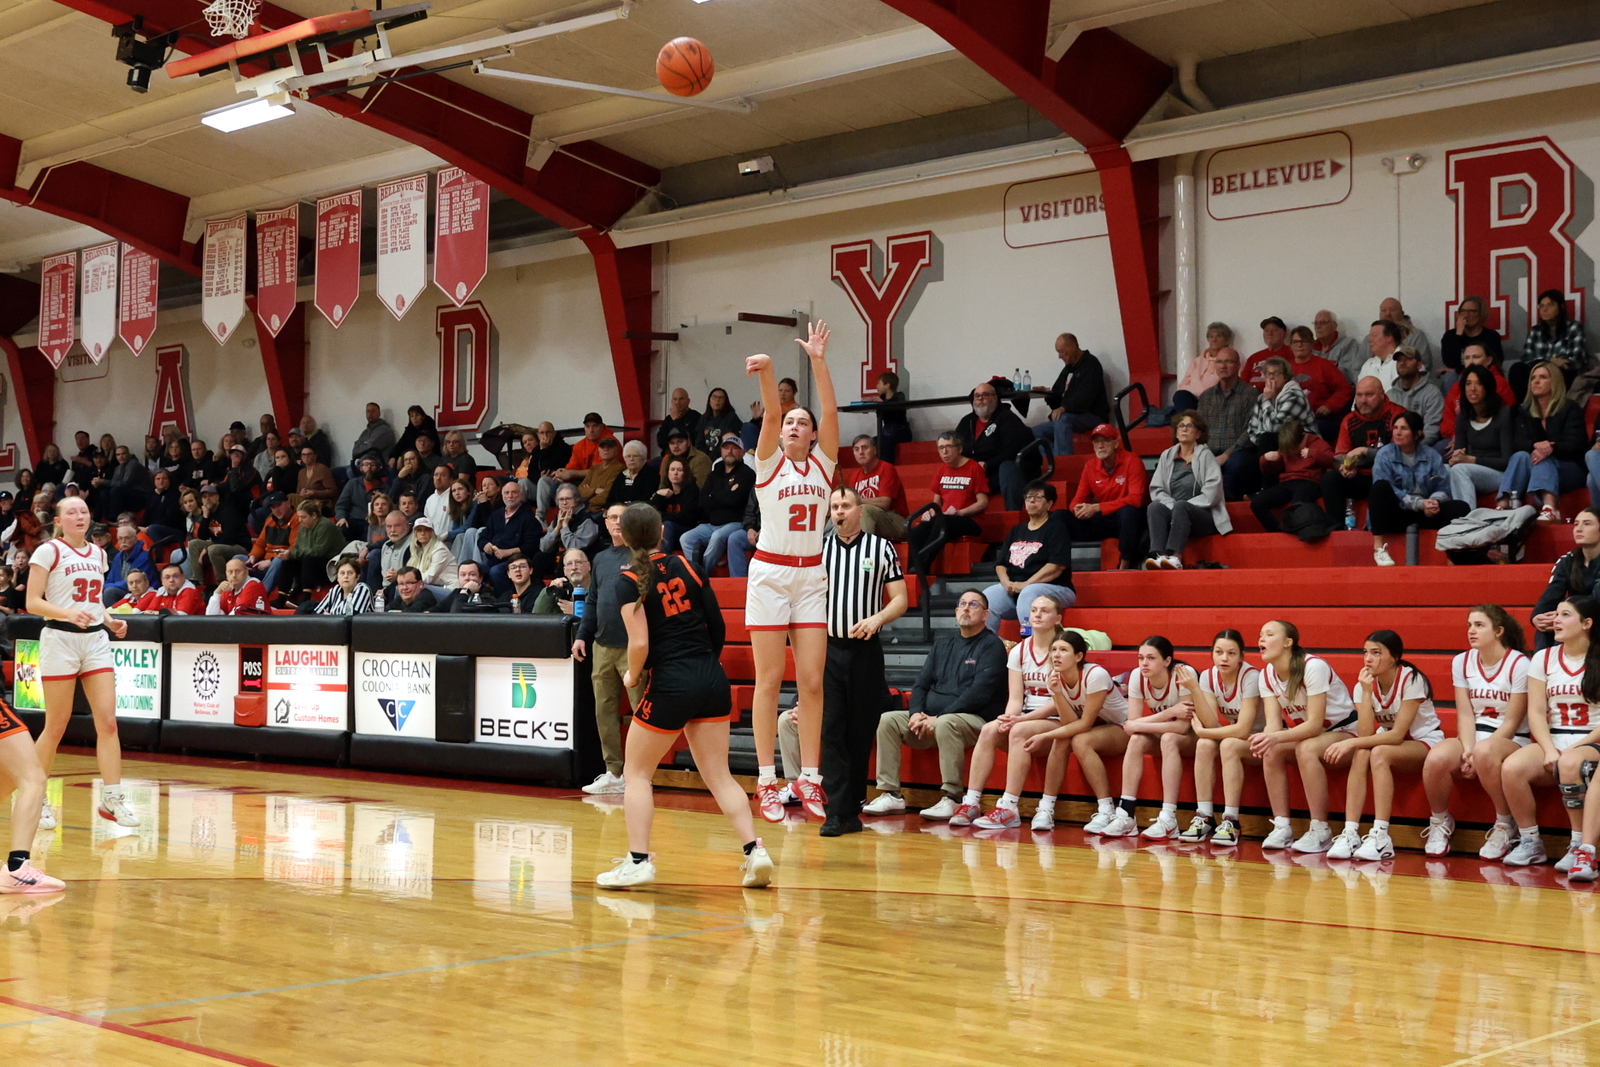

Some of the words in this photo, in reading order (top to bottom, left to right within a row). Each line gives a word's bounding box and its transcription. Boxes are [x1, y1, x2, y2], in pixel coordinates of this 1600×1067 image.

[380, 181, 414, 201] BELLEVUE
[415, 179, 425, 193] HS
[1212, 160, 1326, 196] BELLEVUE
[319, 195, 351, 216] BELLEVUE
[1020, 194, 1106, 223] VISITORS
[1445, 136, 1585, 339] R
[831, 230, 932, 398] Y
[434, 300, 492, 434] D
[145, 344, 193, 446] A
[778, 484, 826, 501] BELLEVUE
[788, 503, 818, 531] 21
[72, 578, 102, 604] 32
[656, 576, 692, 618] 22
[243, 661, 262, 676] POSS
[275, 650, 339, 667] LAUGHLIN
[362, 658, 431, 679] CROGHAN
[362, 680, 401, 693] COLONIA
[407, 682, 431, 695] BANK
[294, 713, 317, 722] Custom
[318, 714, 340, 724] Homes
[1557, 702, 1590, 727] 13
[480, 717, 569, 741] BECK'S
